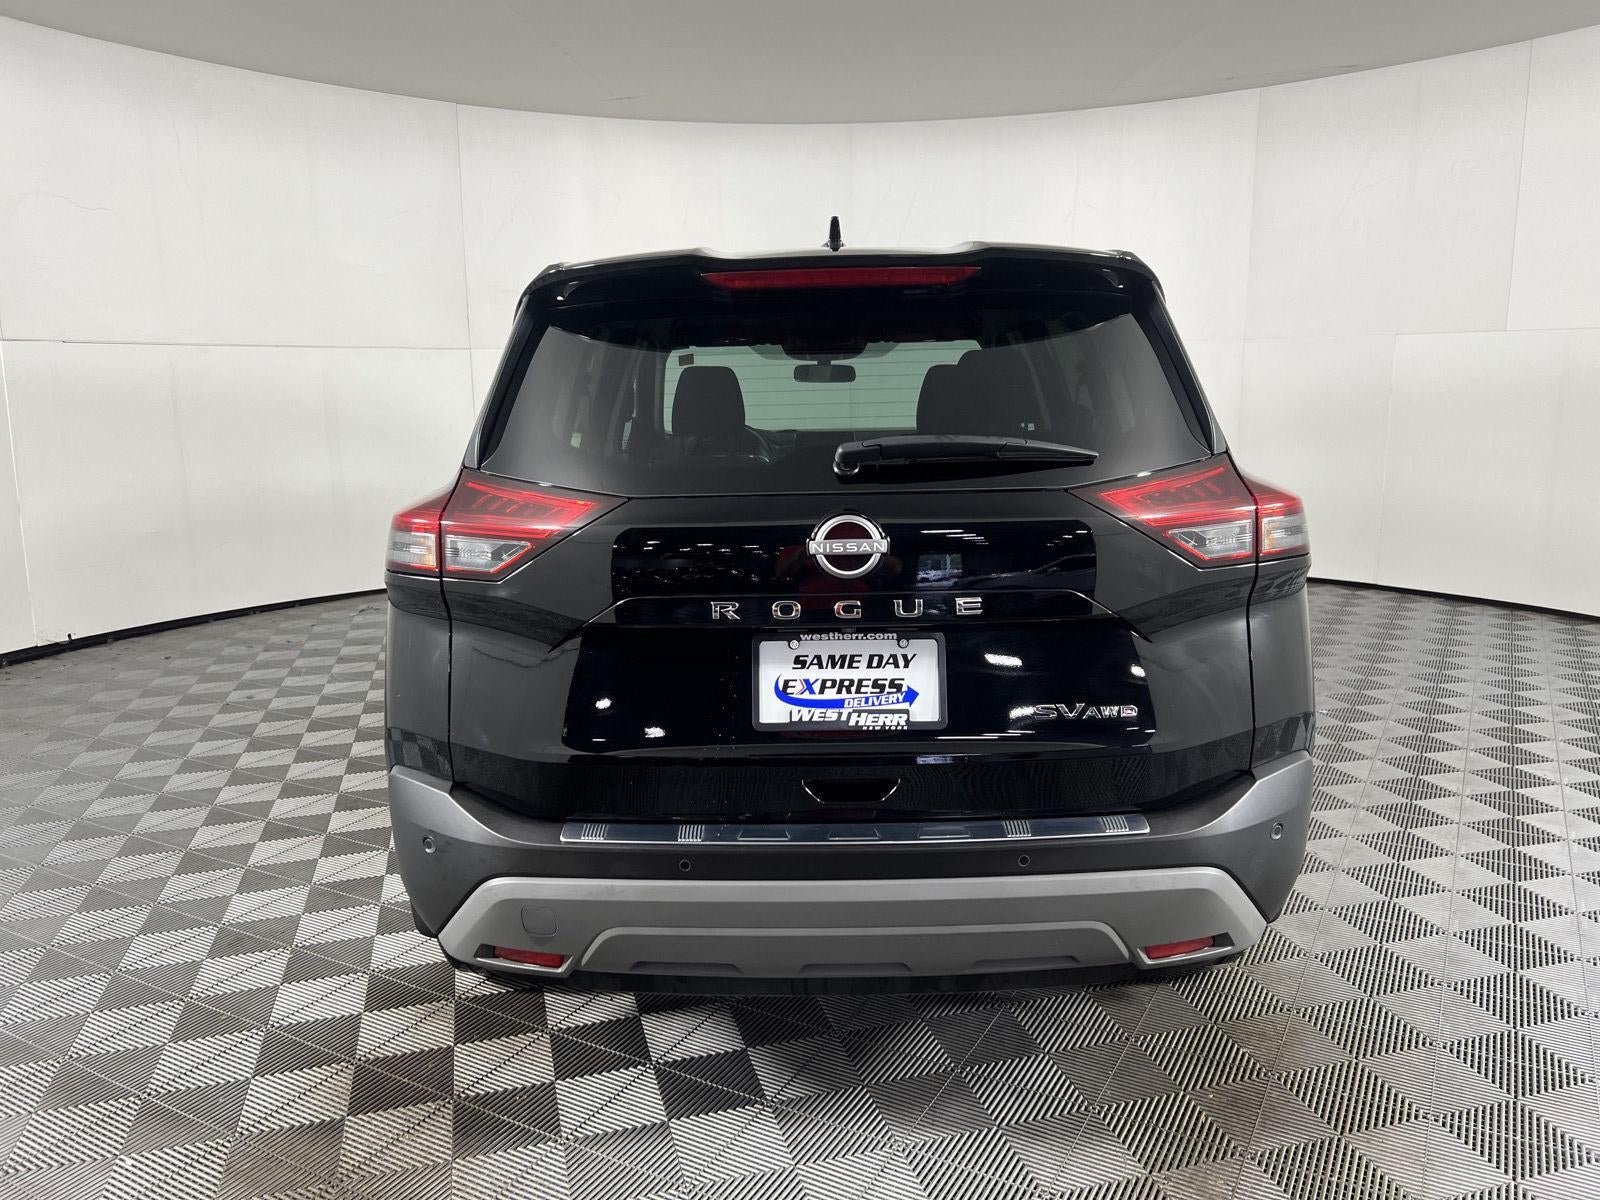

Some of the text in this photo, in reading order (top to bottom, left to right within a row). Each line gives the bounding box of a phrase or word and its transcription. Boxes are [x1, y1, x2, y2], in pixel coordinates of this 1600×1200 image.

[811, 542, 886, 553] NISSAN
[710, 597, 983, 620] ROGUE
[800, 632, 898, 641] westherr.com
[792, 653, 917, 670] SAME DAY
[781, 678, 905, 695] EXPRESS
[843, 692, 906, 708] DELIVERY
[1034, 703, 1138, 720] SV AWD
